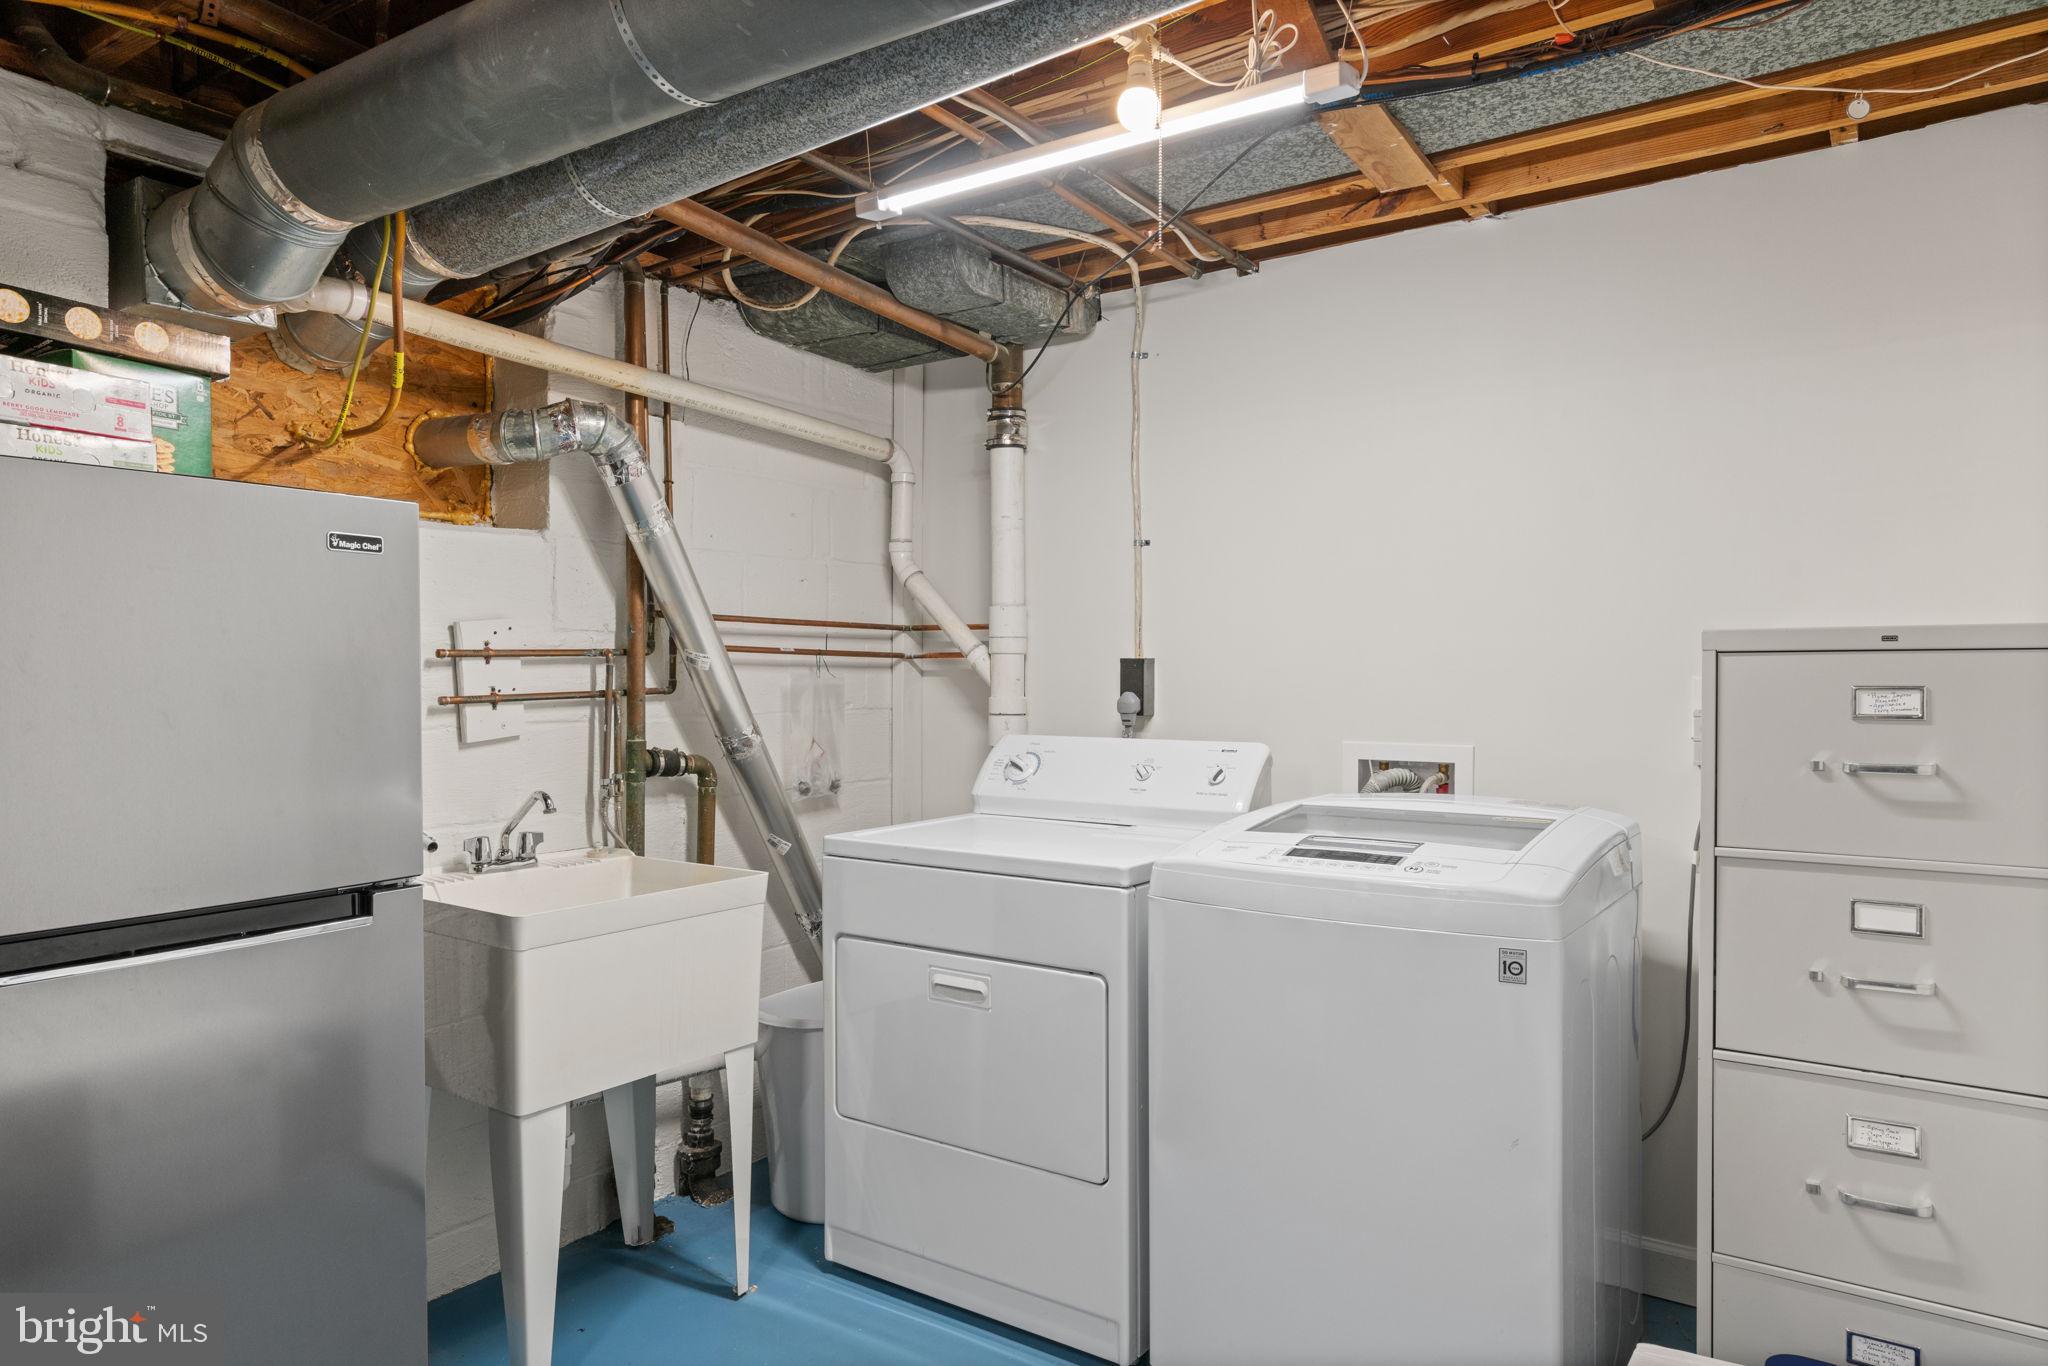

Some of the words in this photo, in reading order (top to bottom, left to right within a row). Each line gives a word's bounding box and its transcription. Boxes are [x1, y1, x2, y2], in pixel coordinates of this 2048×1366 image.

[191, 46, 220, 63] NATURAL
[24, 388, 62, 399] ORGANIC
[2, 401, 23, 409] BERRY
[46, 409, 80, 418] LEMONADE
[116, 415, 124, 427] 8
[339, 540, 361, 549] Magic
[362, 542, 380, 550] Chef
[1502, 960, 1524, 976] 10
